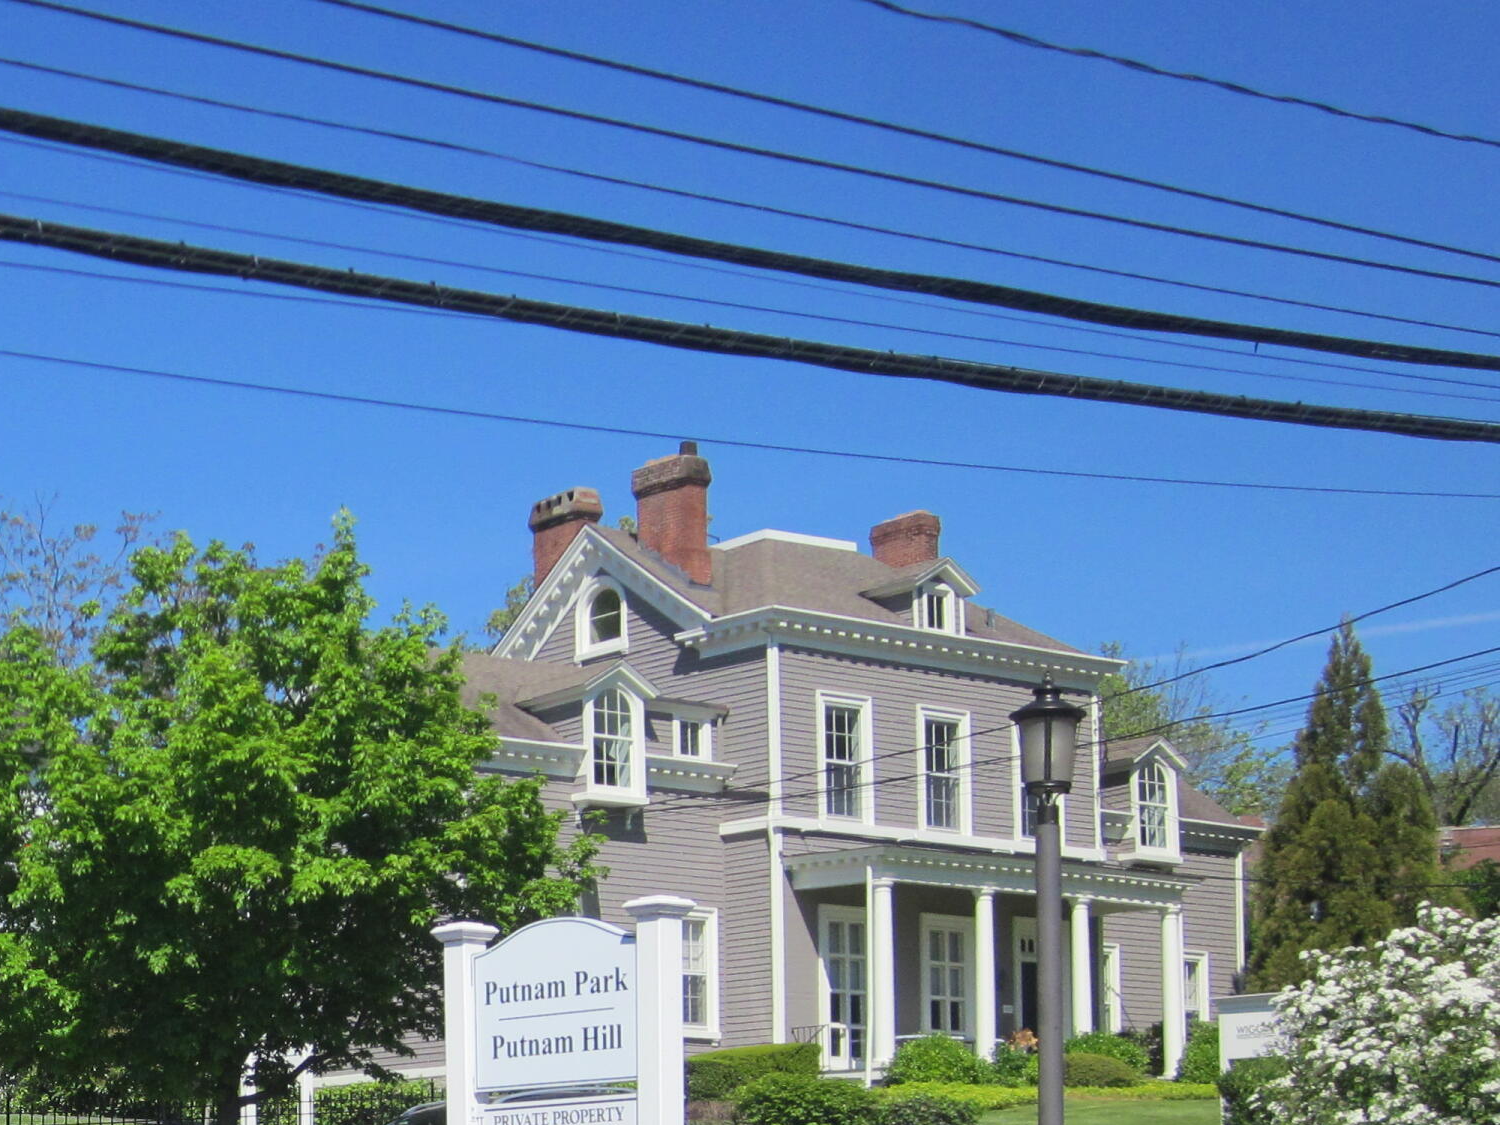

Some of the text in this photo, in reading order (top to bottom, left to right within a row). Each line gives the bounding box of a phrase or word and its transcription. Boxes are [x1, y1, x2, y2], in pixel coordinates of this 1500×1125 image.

[485, 966, 628, 1006] Putnam Park
[492, 1023, 622, 1060] Putnam Hill
[553, 1106, 624, 1125] PROPERTY
